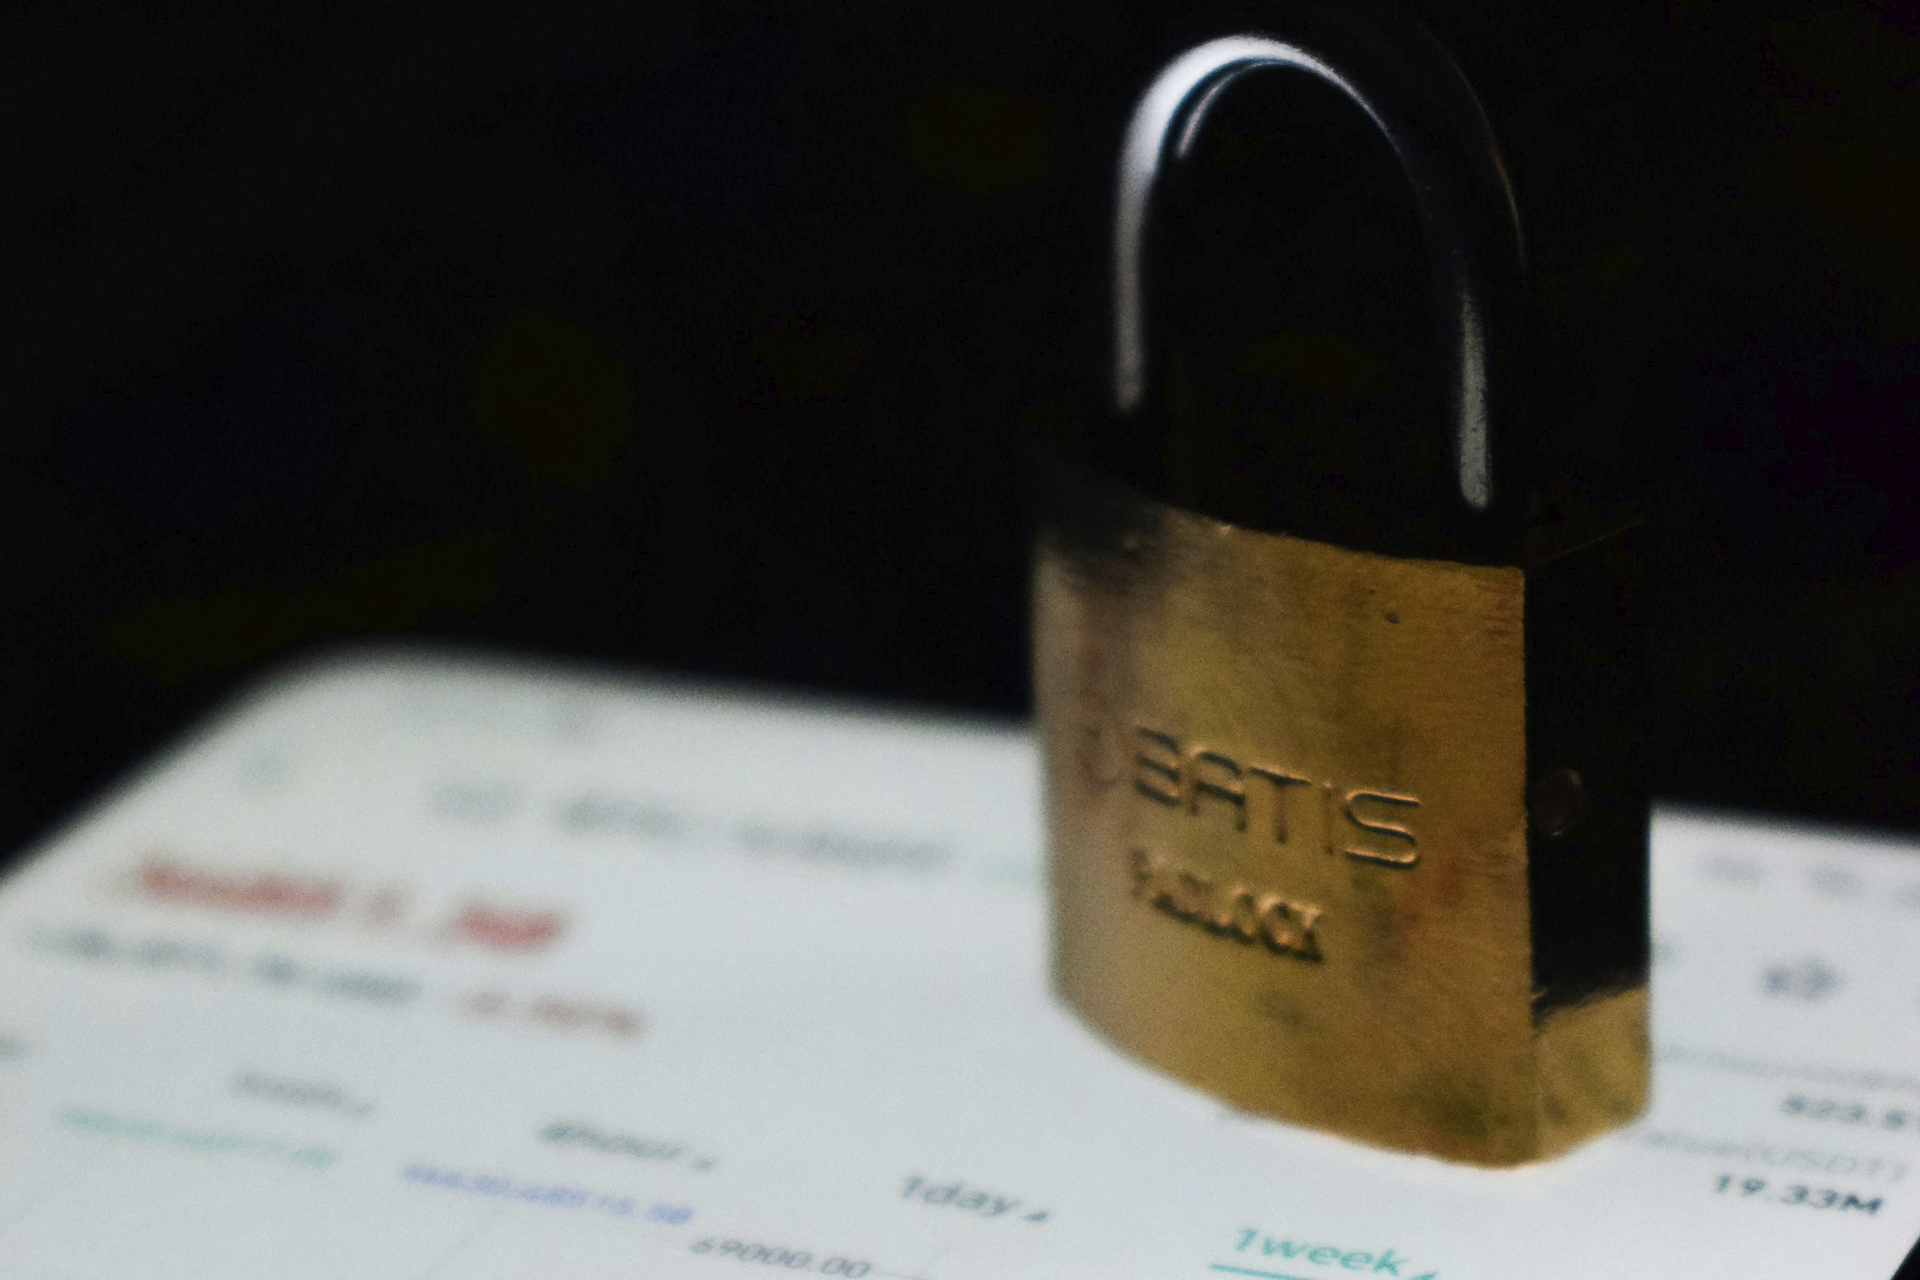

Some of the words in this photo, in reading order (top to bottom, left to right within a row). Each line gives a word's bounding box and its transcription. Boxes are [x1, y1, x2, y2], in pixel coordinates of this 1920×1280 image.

[1132, 724, 1424, 870] SATIS
[1781, 1093, 1920, 1133] 523.5
[901, 1173, 1021, 1219] 1day
[1713, 1172, 1884, 1216] 19.33M
[689, 1234, 872, 1280] 69000.00
[1235, 1226, 1408, 1277] 1week
